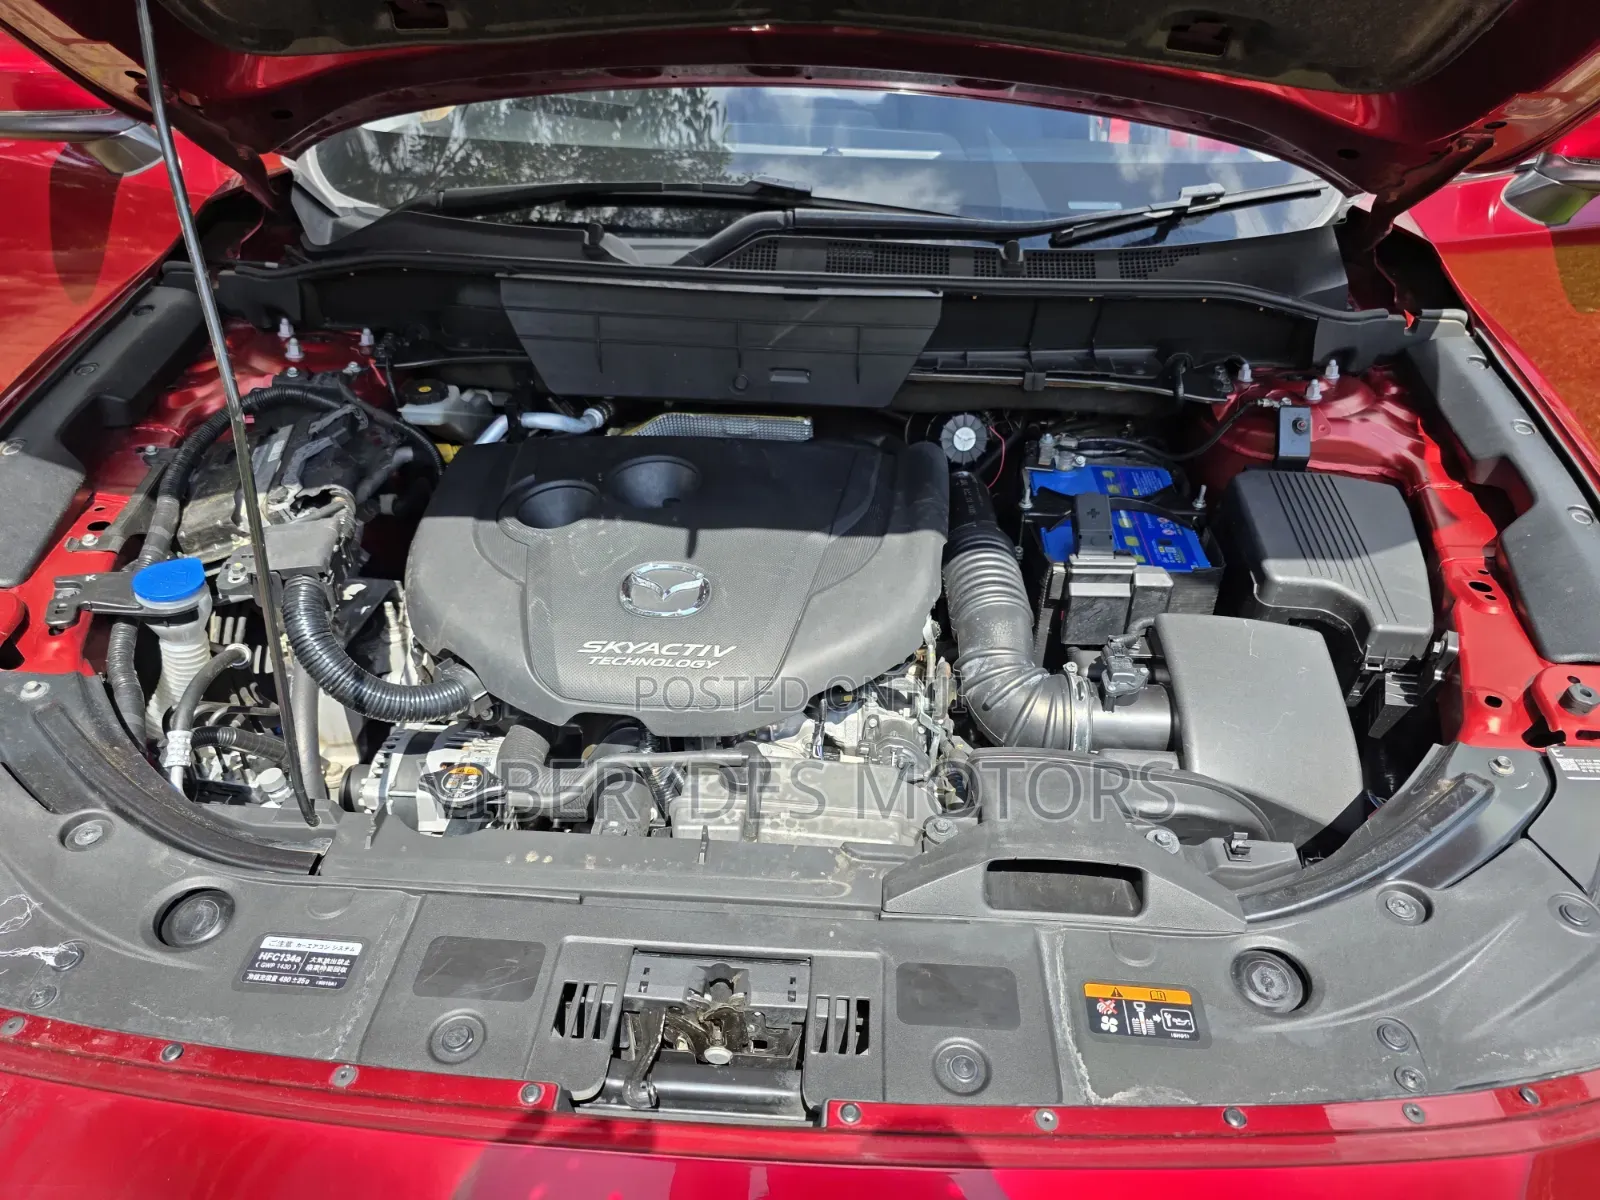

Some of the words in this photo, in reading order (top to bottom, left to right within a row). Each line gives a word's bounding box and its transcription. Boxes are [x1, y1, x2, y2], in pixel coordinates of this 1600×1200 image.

[577, 641, 737, 658] SKYACTIV
[587, 655, 720, 670] TECHNOLOGY
[268, 939, 293, 949] ご注意
[258, 951, 302, 963] HFC134a
